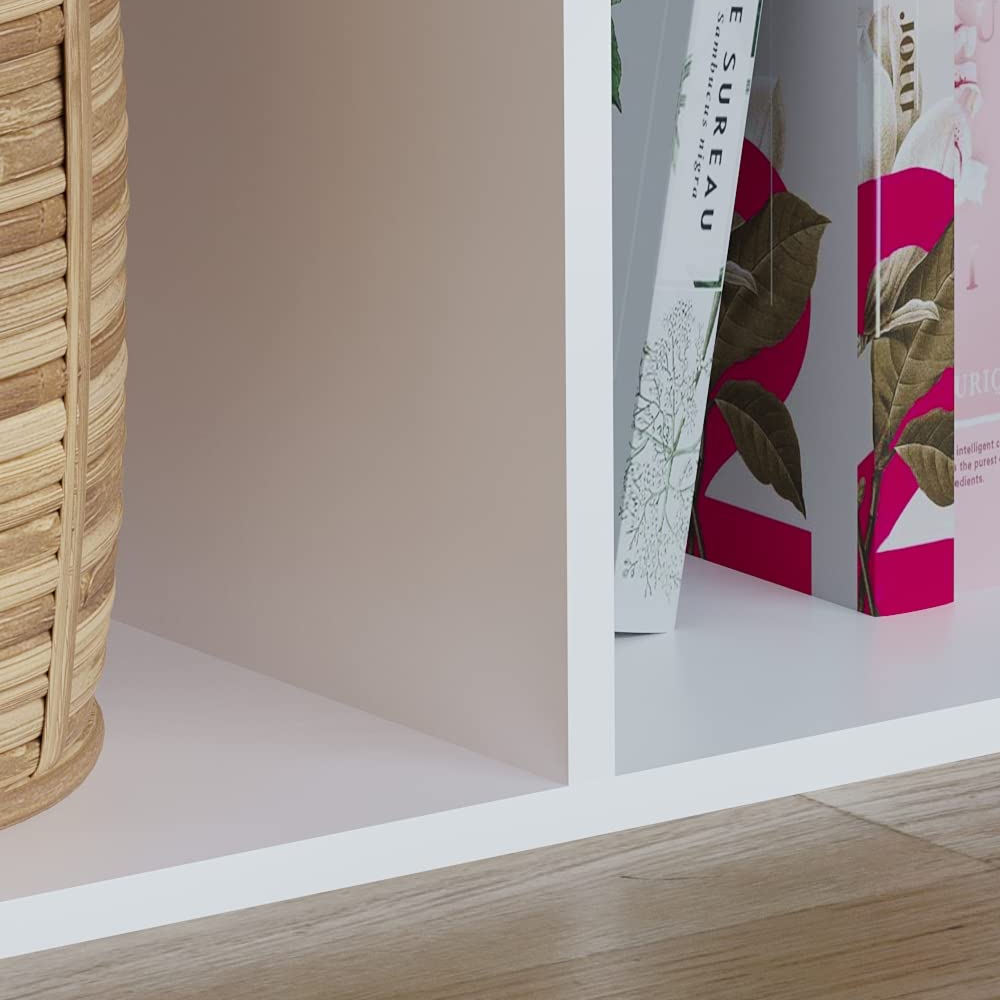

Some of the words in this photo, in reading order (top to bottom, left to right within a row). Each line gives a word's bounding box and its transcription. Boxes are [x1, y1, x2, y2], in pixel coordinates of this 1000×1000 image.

[702, 11, 725, 128] Sambucus
[691, 138, 705, 199] nigra
[700, 52, 736, 231] SUREAU
[956, 441, 995, 456] intelligent
[960, 461, 972, 472] the
[974, 455, 997, 472] purest
